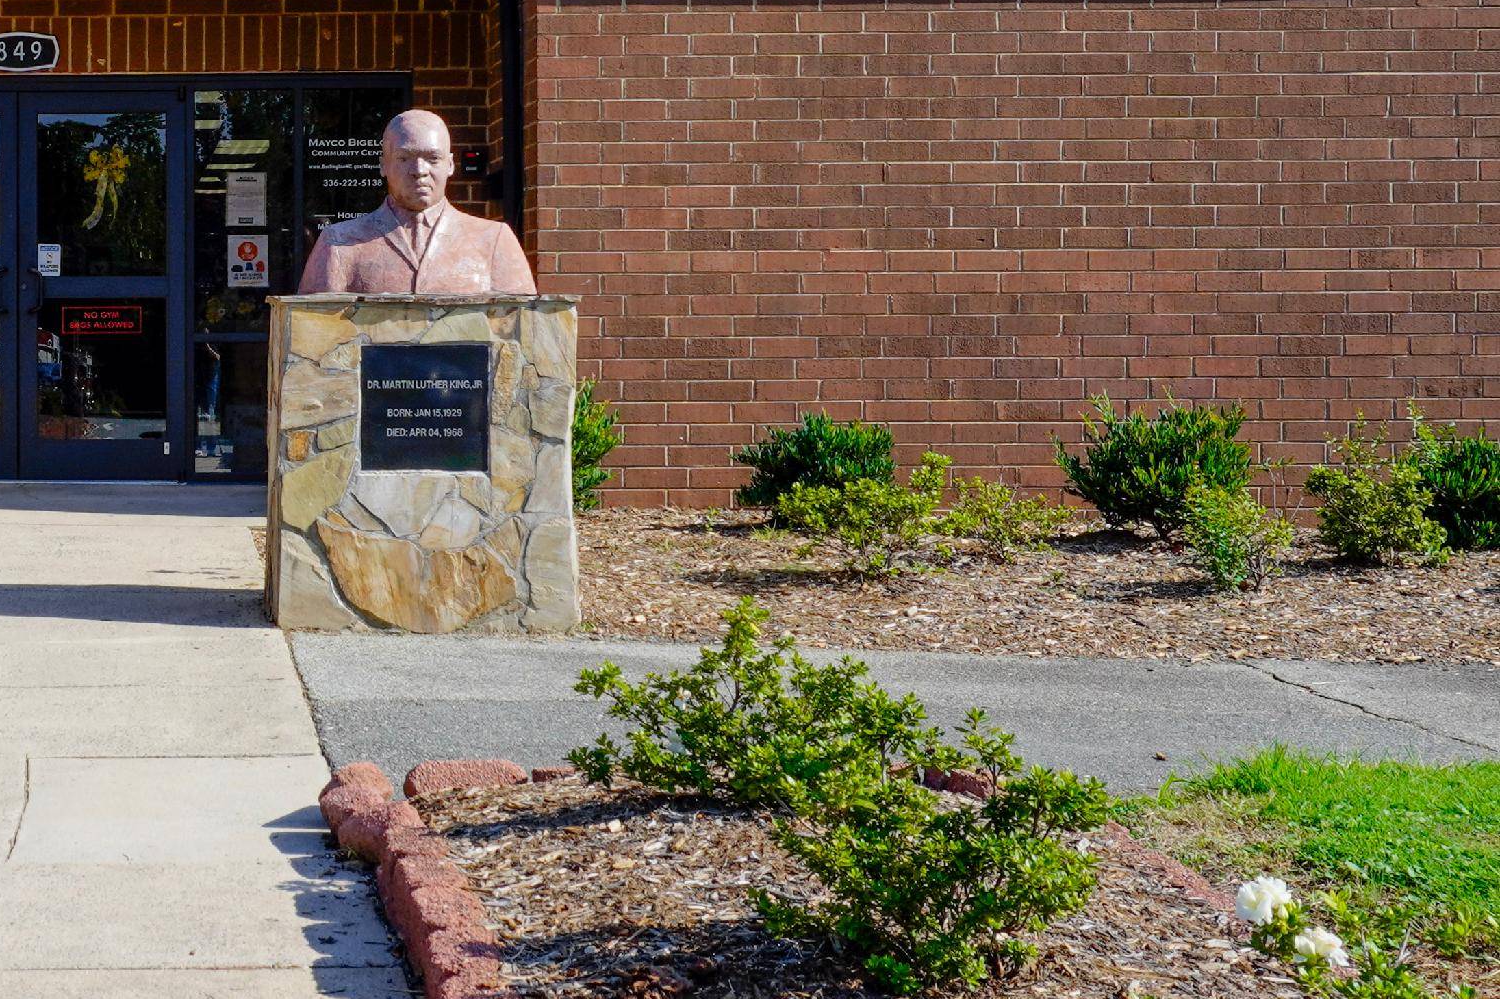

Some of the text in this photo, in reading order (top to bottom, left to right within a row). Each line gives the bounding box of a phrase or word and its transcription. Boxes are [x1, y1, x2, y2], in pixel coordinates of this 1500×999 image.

[308, 138, 384, 147] MAYCO BIGELO
[323, 179, 383, 187] 336-222-5138
[367, 380, 381, 389] DR.
[382, 380, 415, 389] MARTIN
[416, 380, 448, 389] LUTHER
[387, 409, 413, 417] BORN:
[414, 409, 431, 417] JAN
[386, 428, 463, 438] DIED: APR 04, 1968
